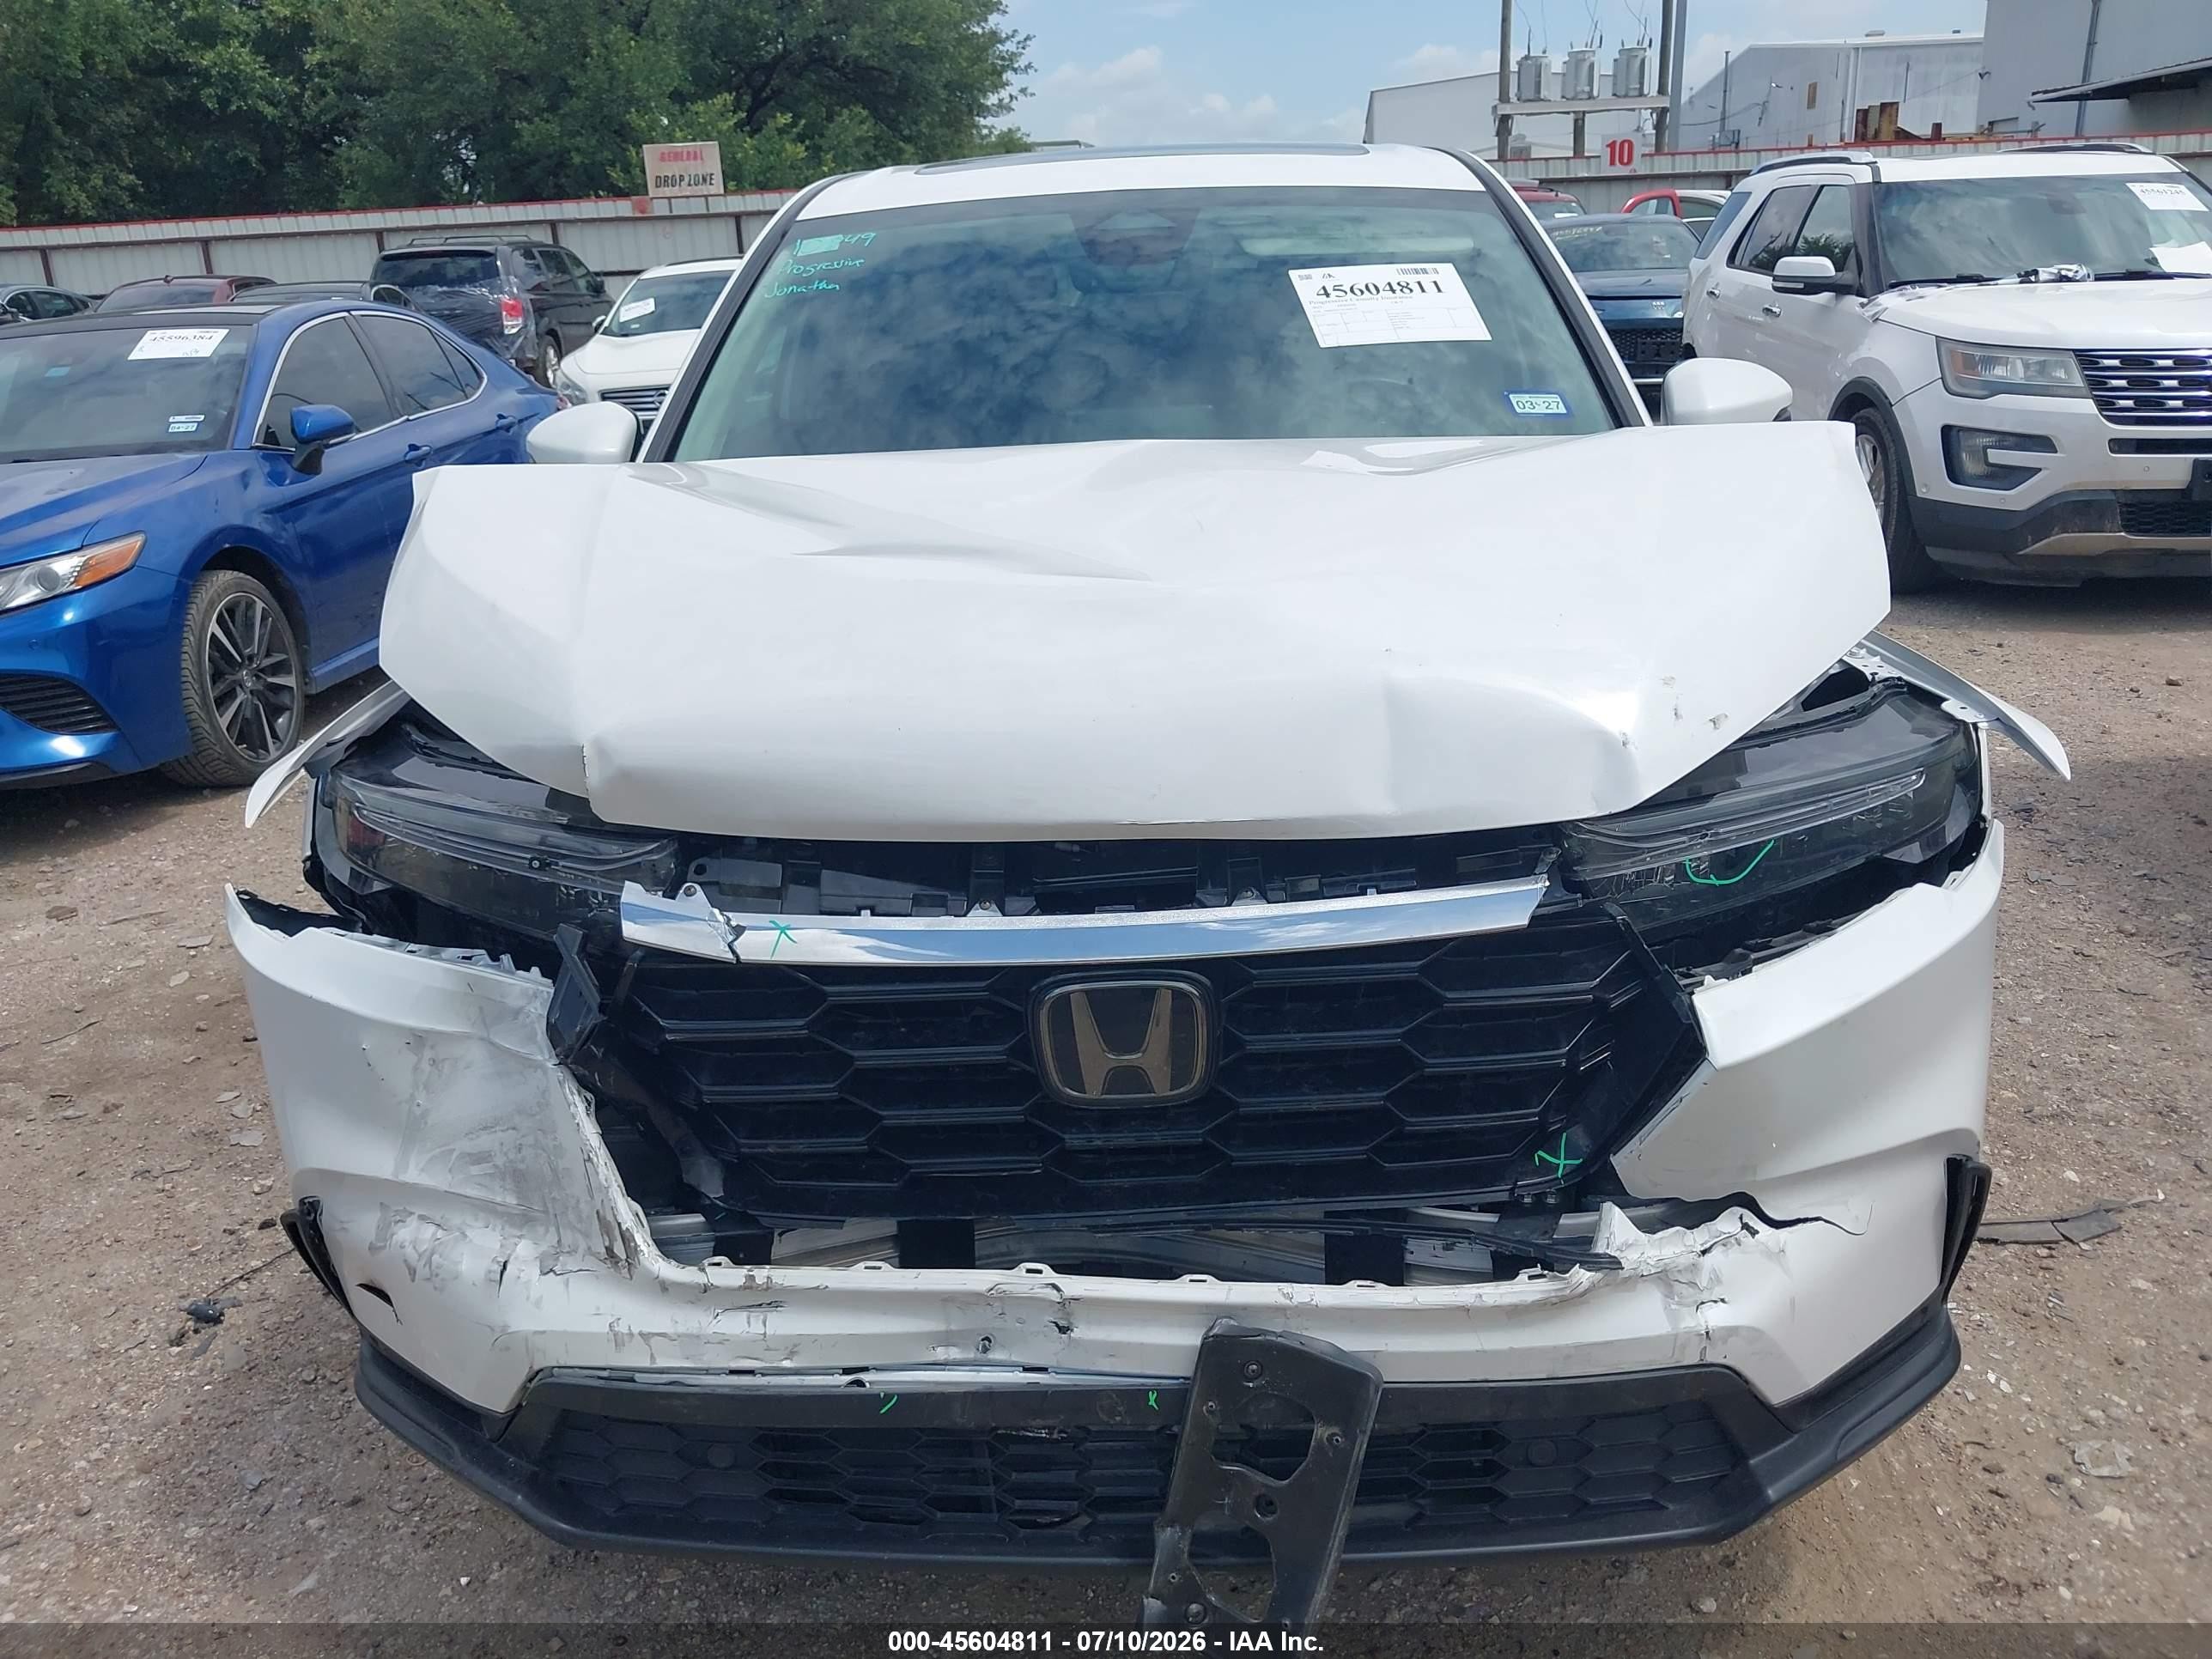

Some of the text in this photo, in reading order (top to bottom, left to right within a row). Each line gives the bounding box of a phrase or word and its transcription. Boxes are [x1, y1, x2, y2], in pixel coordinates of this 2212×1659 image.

[1606, 139, 1634, 166] 10
[655, 173, 714, 188] DROP ZONE
[1316, 280, 1444, 298] 45604811
